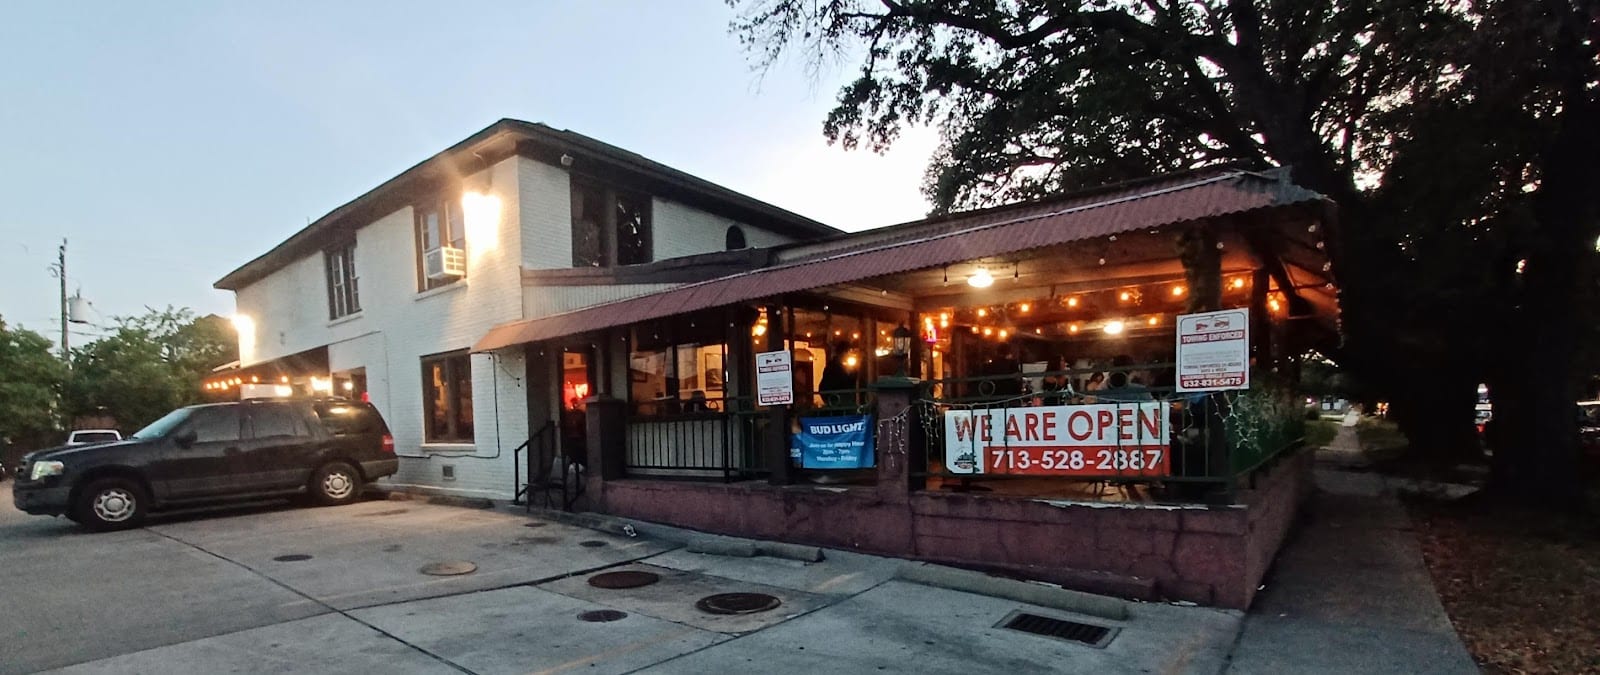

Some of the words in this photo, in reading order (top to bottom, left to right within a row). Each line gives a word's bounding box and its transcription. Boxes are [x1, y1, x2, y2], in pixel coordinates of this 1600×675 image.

[810, 425, 831, 434] BUD
[832, 422, 864, 434] LIGHT
[954, 414, 992, 442] WE
[1006, 412, 1056, 441] ARE
[1068, 408, 1161, 441] OPEN
[992, 449, 1162, 470] 713-528-2887
